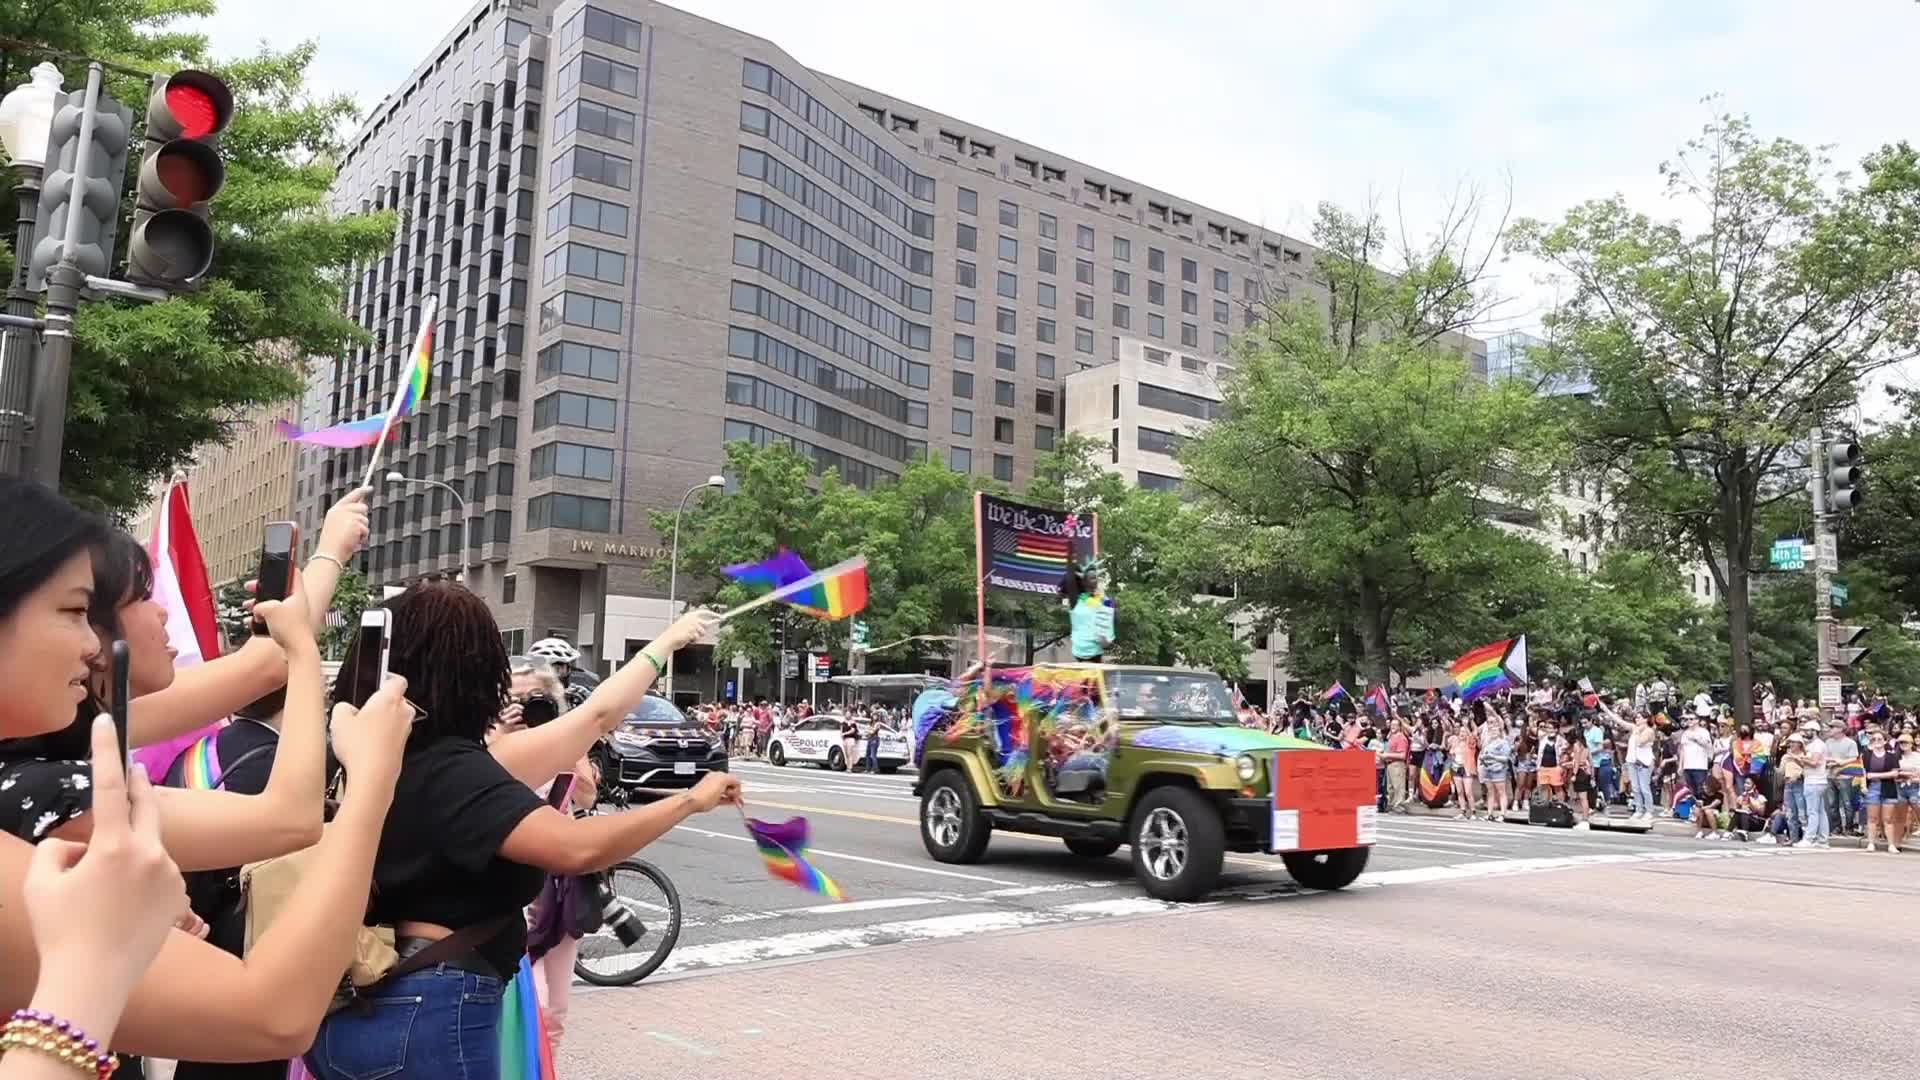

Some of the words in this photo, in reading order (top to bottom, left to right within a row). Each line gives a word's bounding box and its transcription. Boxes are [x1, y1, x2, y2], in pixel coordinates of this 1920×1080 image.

[987, 502, 1013, 525] We
[1037, 513, 1092, 538] Peole
[800, 738, 829, 748] POLICE
